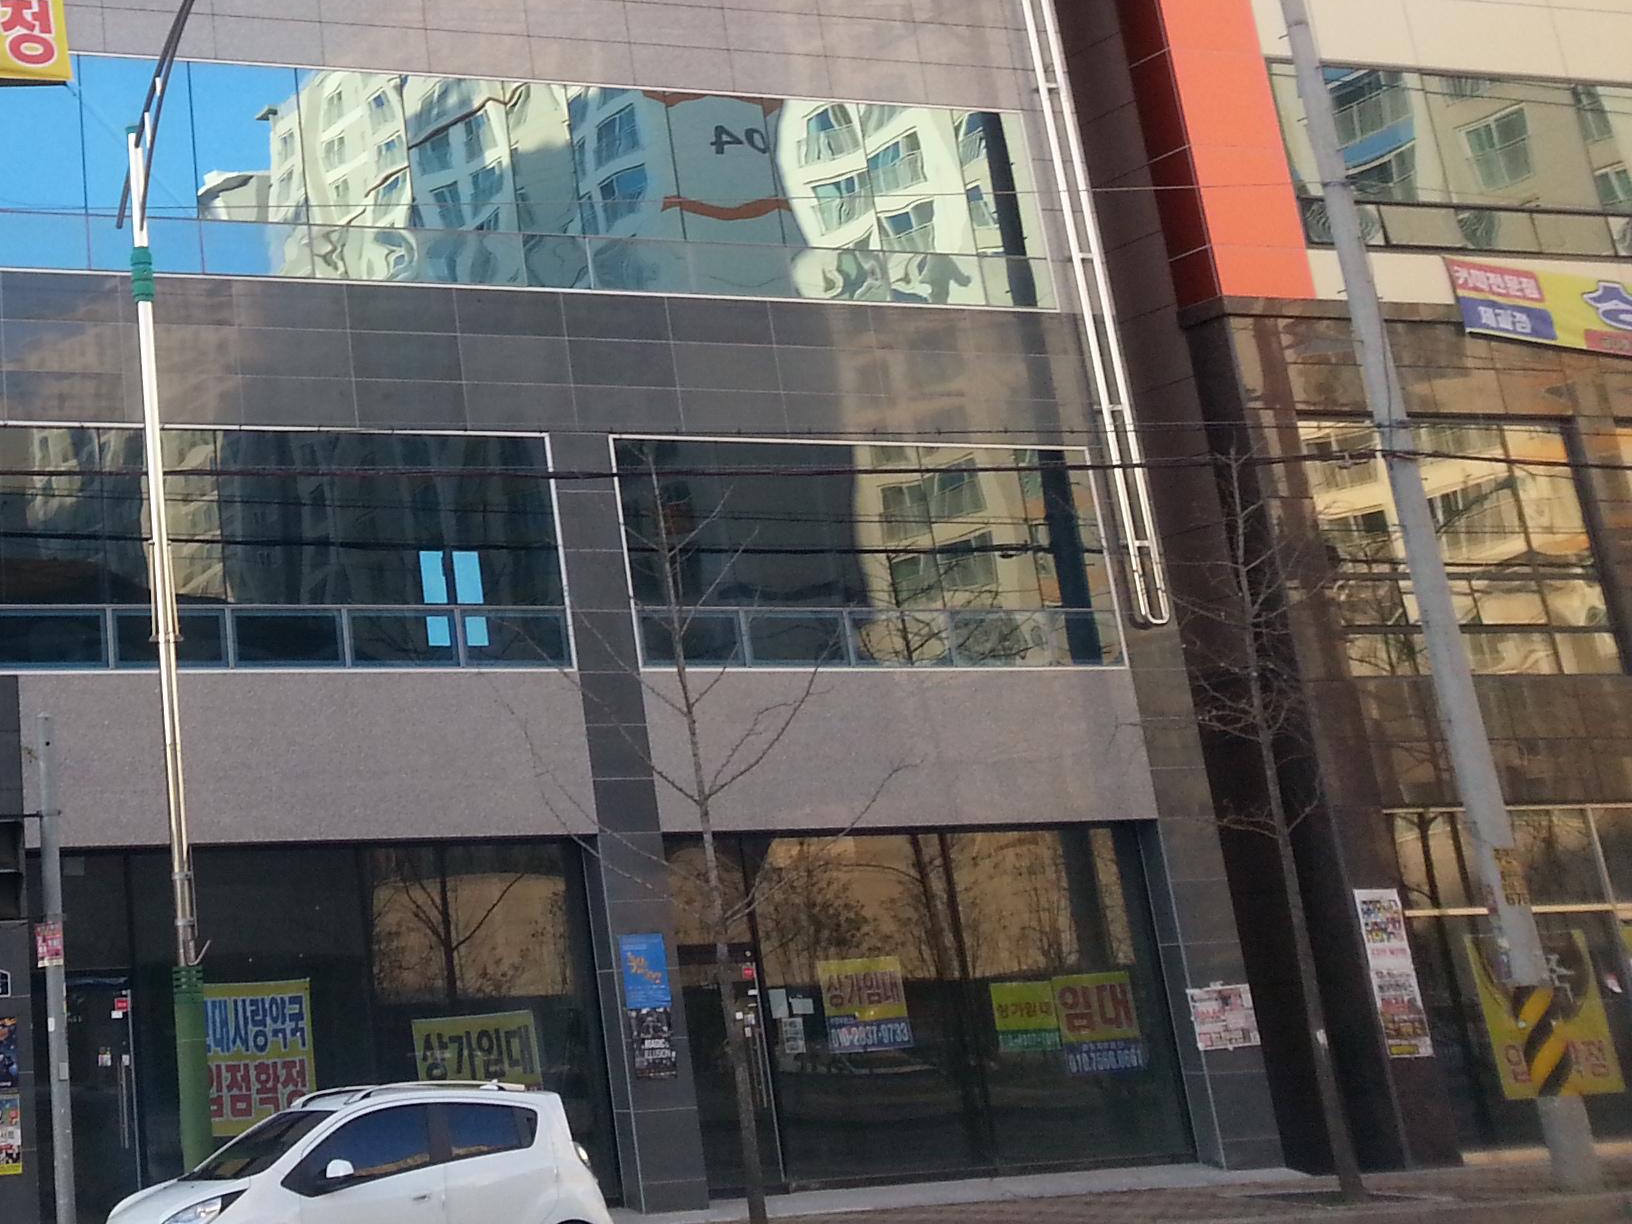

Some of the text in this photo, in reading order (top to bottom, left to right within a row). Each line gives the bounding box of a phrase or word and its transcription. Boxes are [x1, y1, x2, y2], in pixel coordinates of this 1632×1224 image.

[826, 969, 901, 1008] 상가임대
[1058, 982, 1136, 1034] 임대
[421, 1024, 536, 1080] 상가임대
